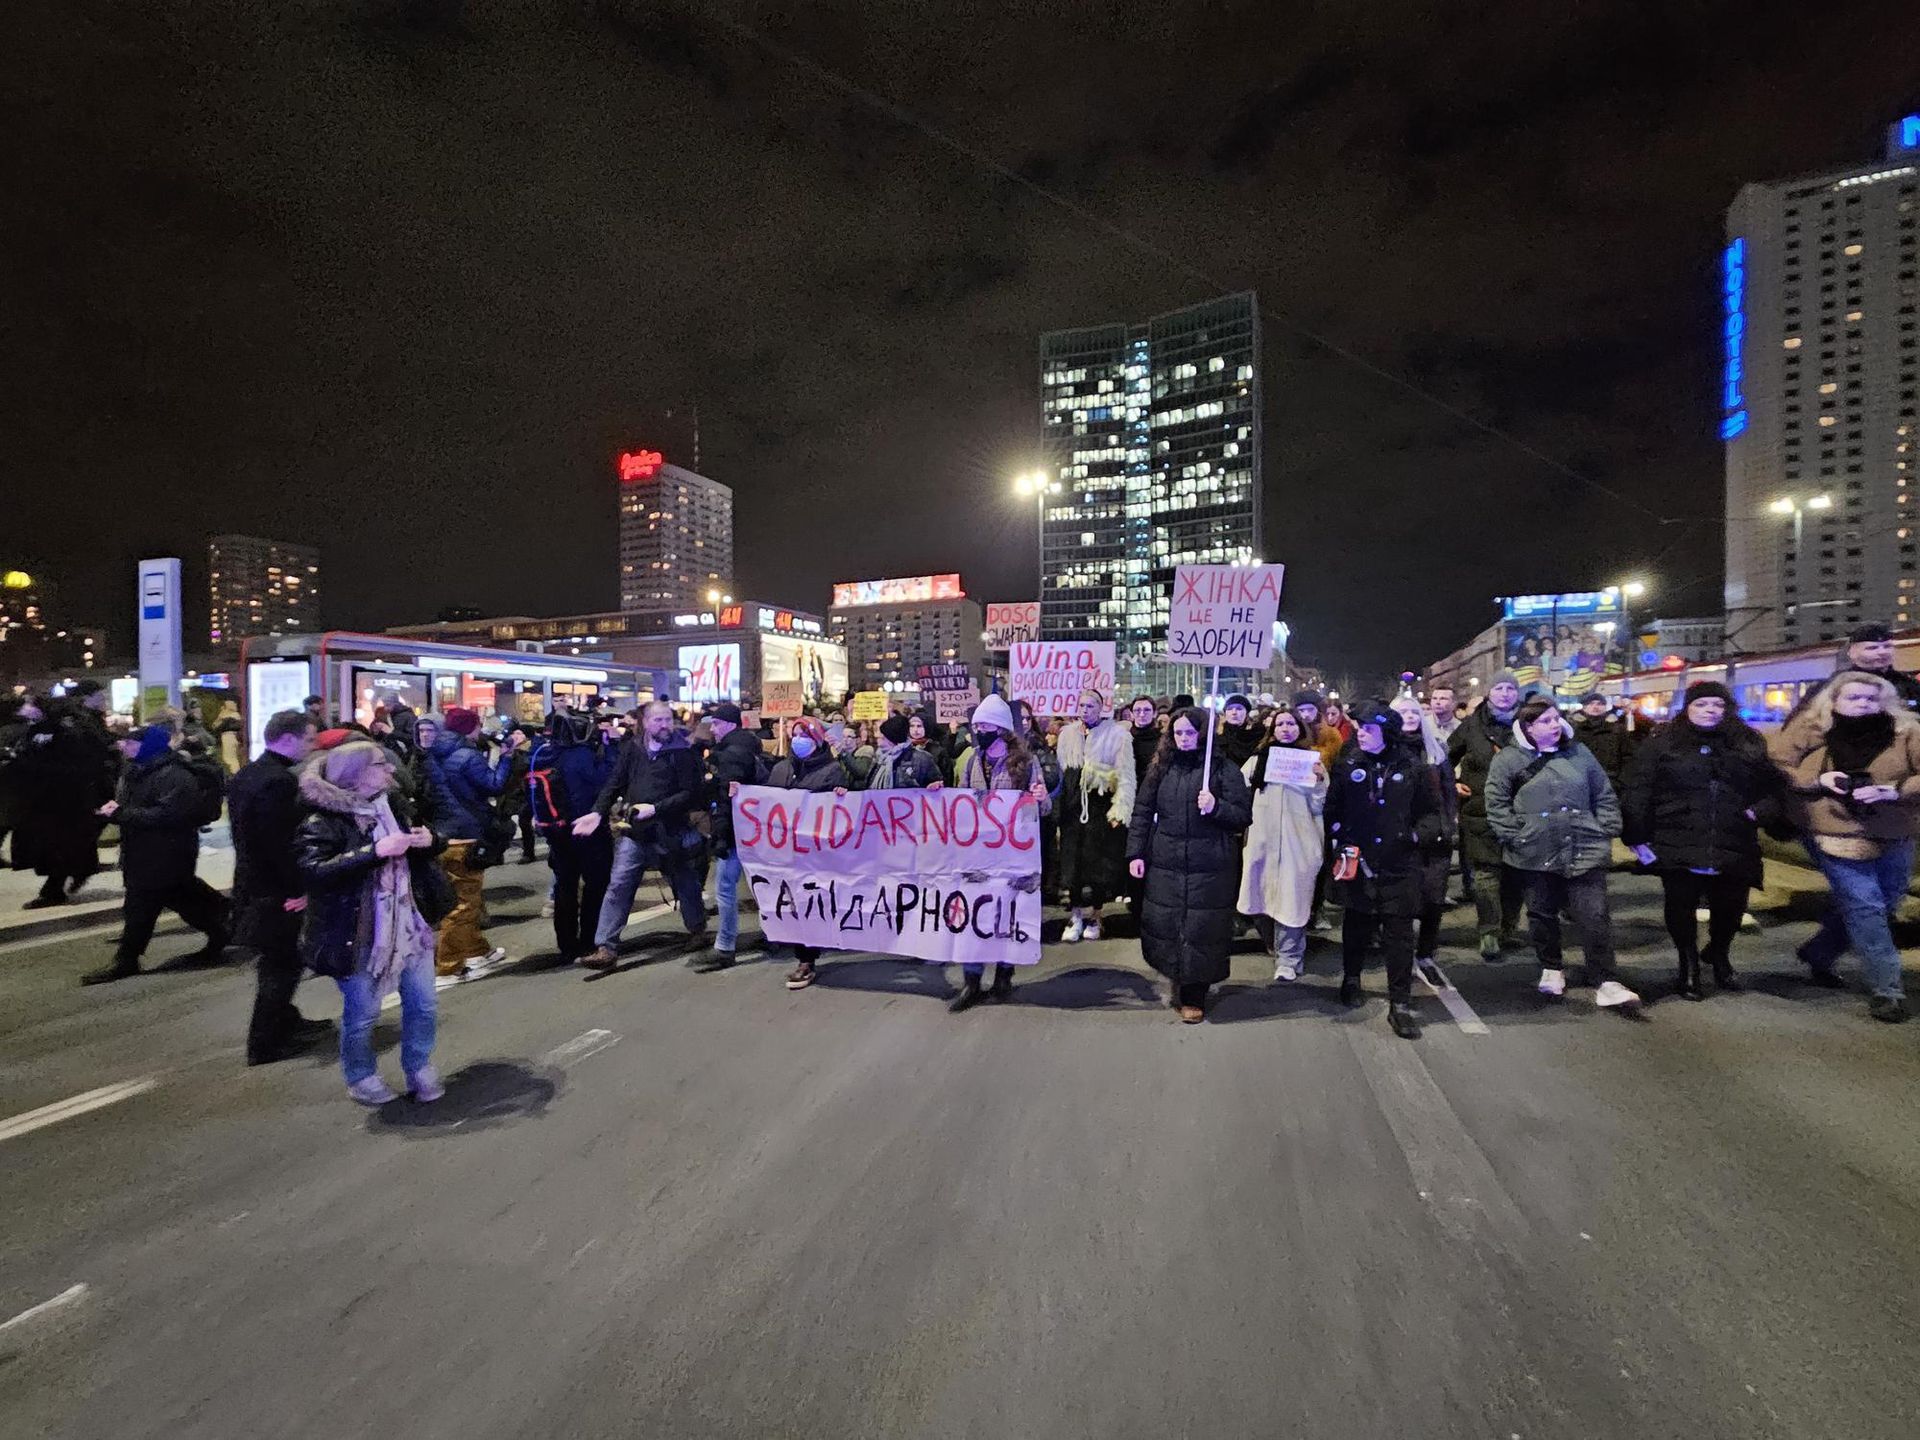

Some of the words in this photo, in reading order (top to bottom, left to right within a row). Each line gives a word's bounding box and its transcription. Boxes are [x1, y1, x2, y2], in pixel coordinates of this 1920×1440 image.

[1176, 570, 1278, 605] ЖІНКА
[1188, 608, 1212, 625] ЦЕ
[1230, 607, 1255, 623] НЕ
[1171, 628, 1263, 659] ЗДОБИЧ
[1016, 643, 1099, 670] Wina
[940, 692, 973, 702] STOP
[1051, 690, 1113, 713] ofiy
